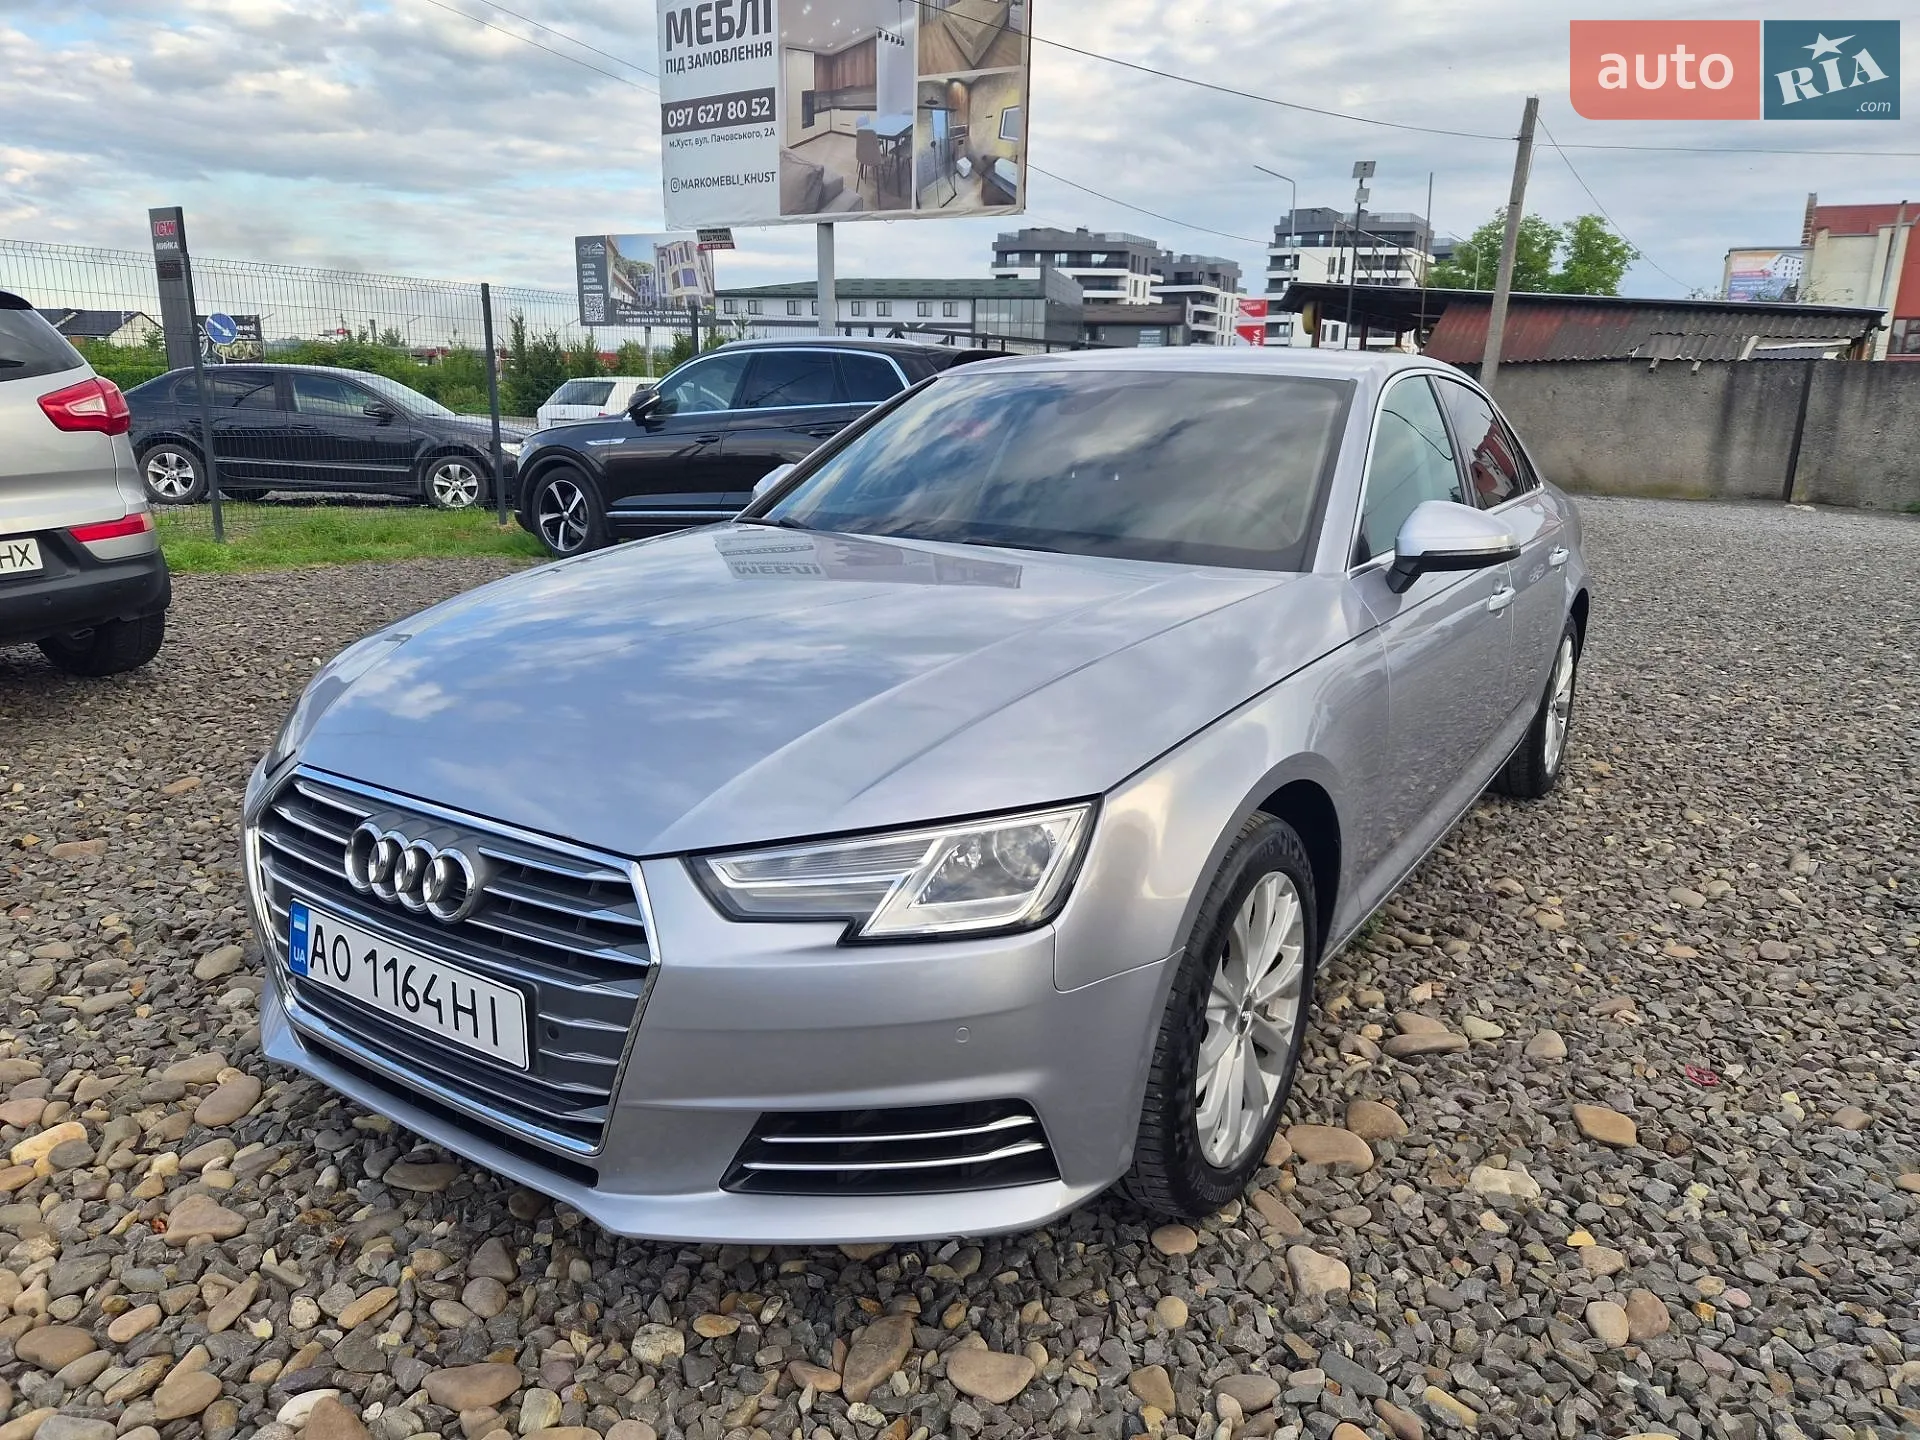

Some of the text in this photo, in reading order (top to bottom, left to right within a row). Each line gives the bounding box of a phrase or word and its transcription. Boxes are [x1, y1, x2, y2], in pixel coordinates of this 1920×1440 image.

[666, 0, 772, 52] МЕБЛІ
[666, 41, 773, 75] ПІД ЗАМОВЛЕННЯ
[667, 96, 770, 128] 097 627 80 52
[710, 131, 763, 143] Пачовського,
[156, 241, 179, 250] МИЙКА
[293, 946, 306, 964] UA
[310, 924, 350, 983] AO
